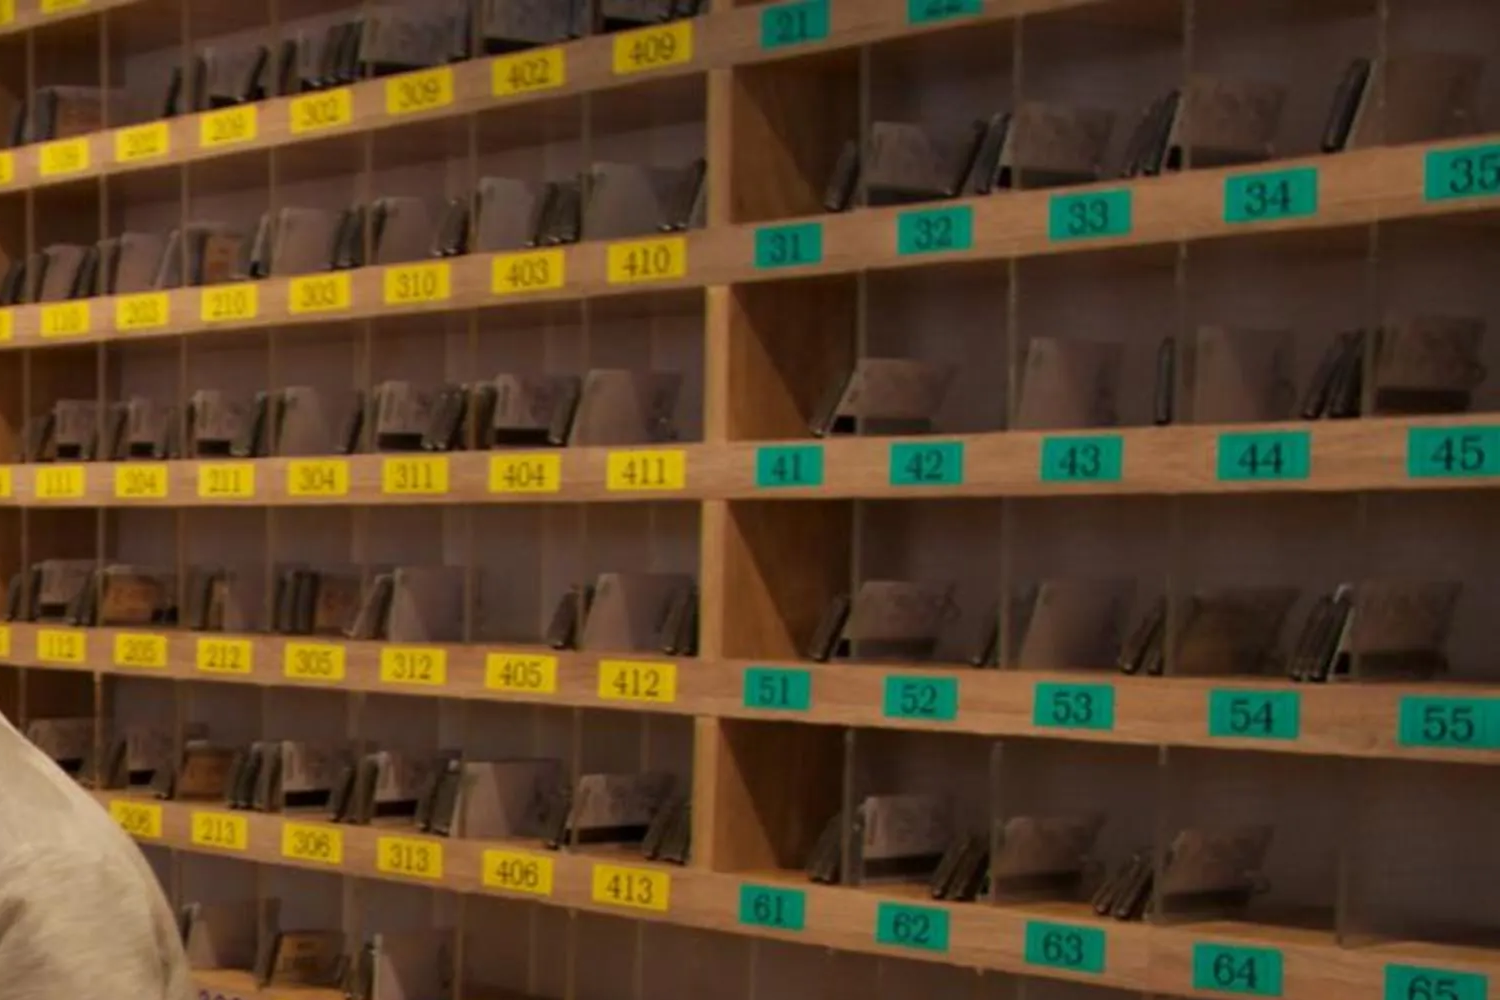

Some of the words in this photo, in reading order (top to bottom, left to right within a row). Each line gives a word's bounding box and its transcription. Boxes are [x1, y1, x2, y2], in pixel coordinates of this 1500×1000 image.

[775, 7, 808, 42] 21
[628, 32, 677, 65] 409
[507, 57, 550, 90] 402
[399, 78, 442, 109] 309
[301, 97, 340, 127] 302
[1449, 152, 1500, 194] 35
[1244, 178, 1292, 216] 34
[913, 214, 954, 250] 32
[1067, 198, 1110, 236] 33
[623, 246, 671, 278] 410
[768, 230, 802, 264] 31
[396, 270, 438, 300] 310
[505, 258, 550, 288] 403
[211, 290, 247, 319] 210
[300, 279, 338, 308] 303
[770, 451, 802, 484] 41
[905, 449, 944, 481] 42
[1059, 443, 1100, 477] 43
[1239, 442, 1284, 475] 44
[1432, 435, 1485, 472] 45
[44, 472, 74, 496] 111
[208, 469, 241, 494] 211
[299, 466, 336, 492] 304
[395, 462, 433, 490] 311
[503, 461, 546, 488] 404
[622, 457, 666, 486] 411
[205, 644, 241, 670] 212
[295, 649, 333, 676] 305
[392, 652, 433, 681] 312
[499, 661, 542, 688] 405
[613, 668, 660, 698] 412
[758, 673, 791, 707] 51
[899, 683, 938, 716] 52
[1051, 690, 1094, 725] 53
[1229, 698, 1275, 735] 54
[1423, 705, 1475, 743] 55
[201, 818, 236, 845] 213
[293, 830, 332, 858] 306
[389, 843, 430, 873] 313
[496, 859, 539, 888] 406
[606, 874, 653, 905] 413
[753, 892, 785, 926] 61
[892, 911, 932, 946] 62
[1041, 929, 1084, 967] 63
[1212, 952, 1259, 991] 64
